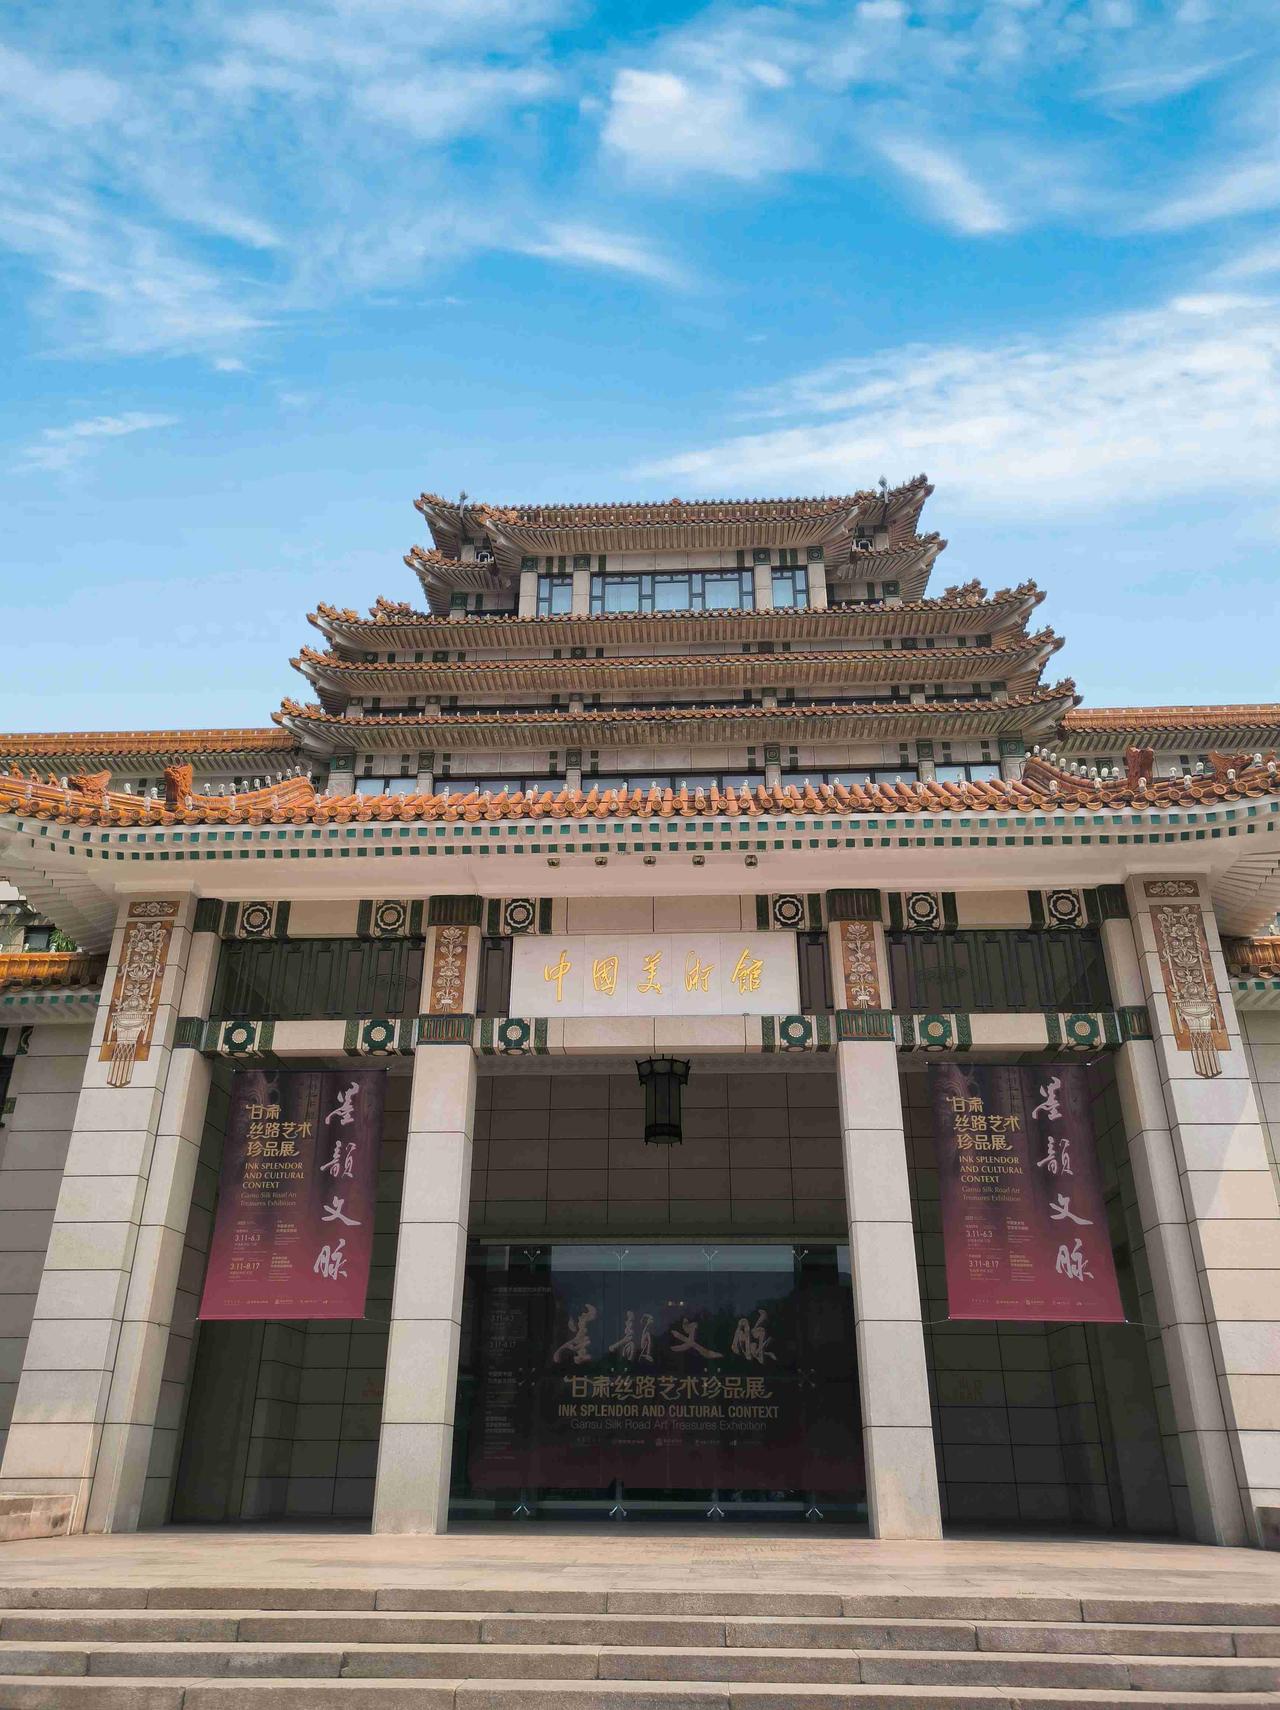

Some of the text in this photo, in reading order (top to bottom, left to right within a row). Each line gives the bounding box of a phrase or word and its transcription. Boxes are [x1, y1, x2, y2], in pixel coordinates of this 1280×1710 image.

[245, 1103, 282, 1121] 甘肃
[946, 1096, 985, 1113] 甘肃
[246, 1121, 313, 1140] 丝路艺术
[953, 1115, 1021, 1132] 丝路艺术
[246, 1141, 300, 1157] 珍品展
[957, 1134, 1014, 1151] 珍品展
[245, 1162, 303, 1170] INK SPLENDOR
[959, 1155, 1019, 1164] INK SPLENDOR
[243, 1171, 305, 1179] AND CULTURAL
[981, 1166, 1024, 1174] CULTURAL
[242, 1181, 280, 1189] CONTEXT
[960, 1175, 999, 1183] CONTEXT
[563, 1375, 773, 1401] 甘肃丝路艺术珍品展
[558, 1404, 779, 1419] INK SPLENDOR AND CULTURAL CONTEXT
[570, 1419, 767, 1431] Gansu Silk Road Art Treasures Exhibition
